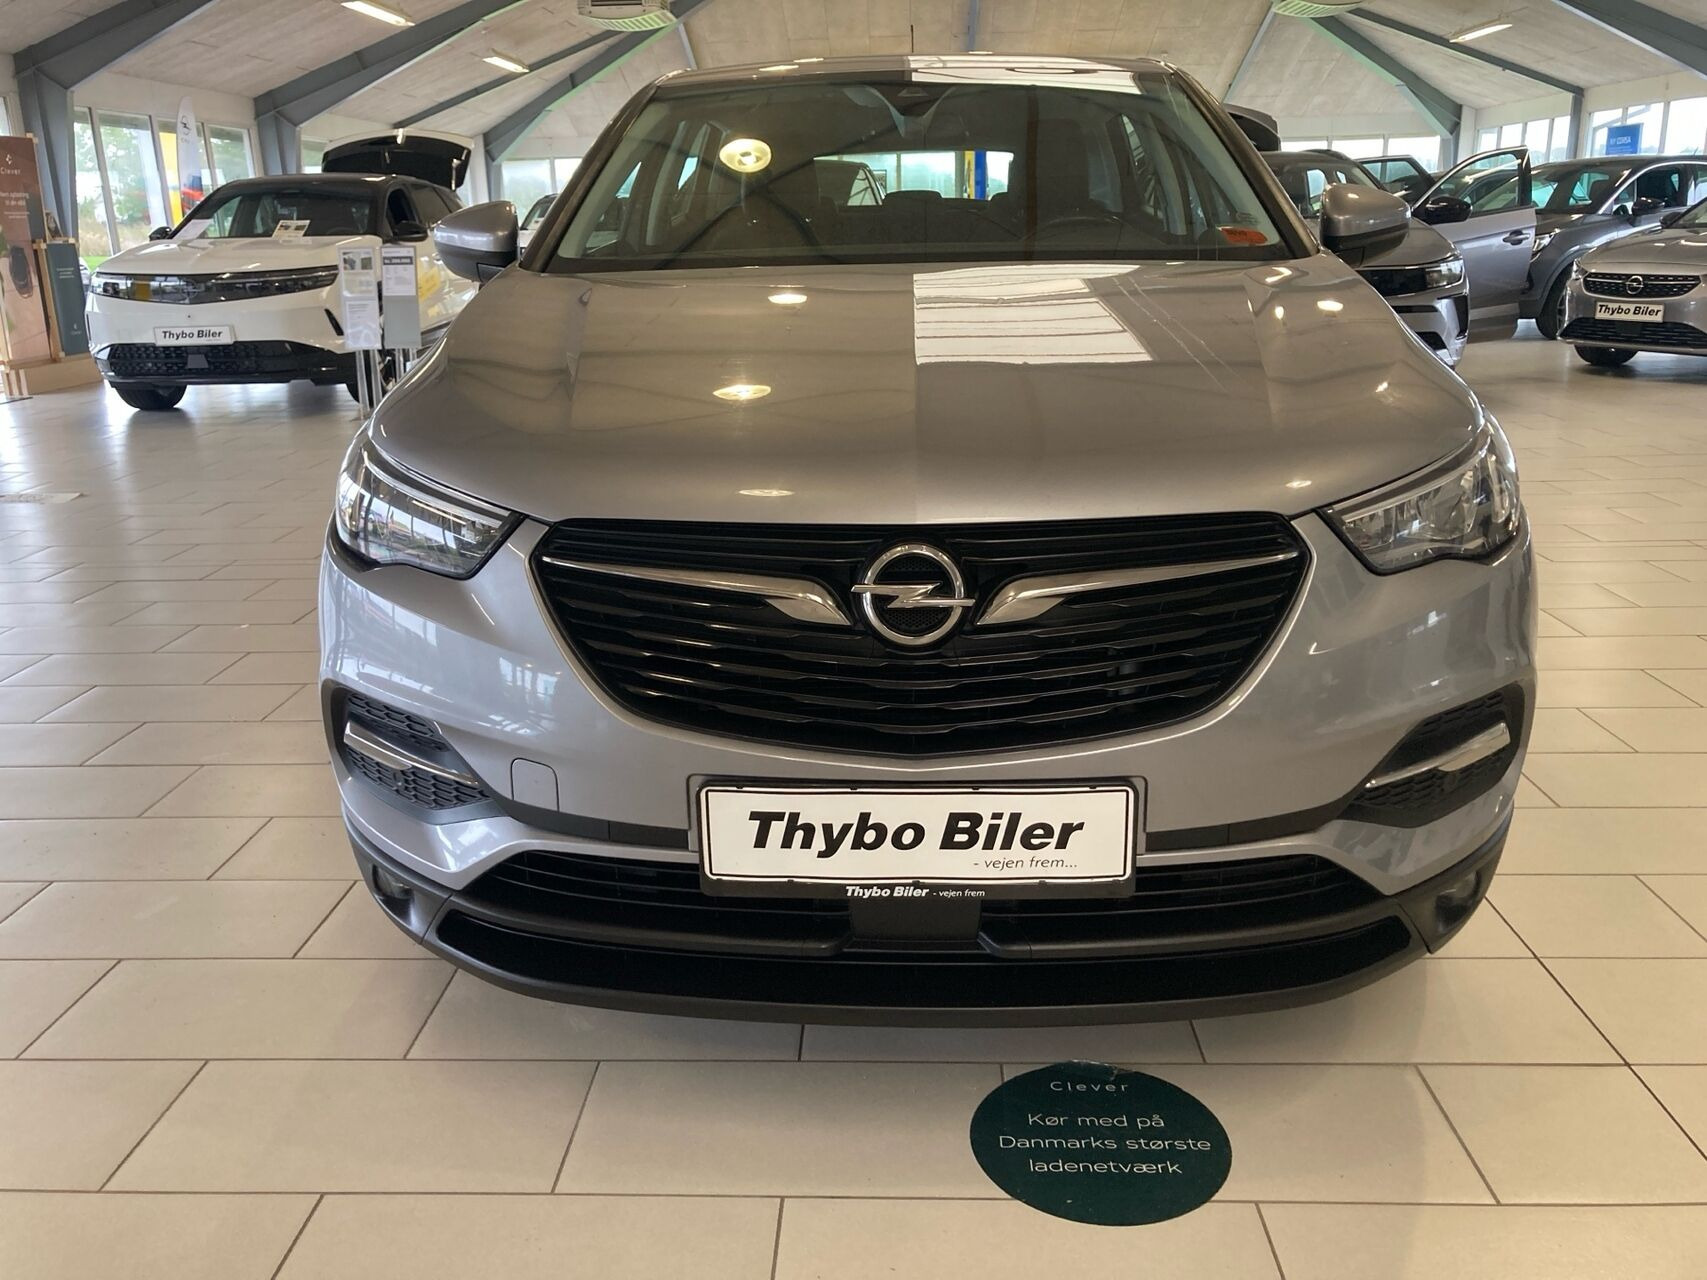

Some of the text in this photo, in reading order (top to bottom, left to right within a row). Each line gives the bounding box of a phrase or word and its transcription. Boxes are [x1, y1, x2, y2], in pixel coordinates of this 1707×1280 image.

[1599, 304, 1661, 317] Thybo Biler
[162, 329, 223, 341] Thybo Biler
[748, 811, 1085, 859] Thybo Biler
[984, 857, 1024, 871] vejen
[1029, 856, 1078, 869] frem...
[845, 886, 891, 898] Thybo
[893, 886, 929, 897] Biler
[938, 889, 962, 898] vejen
[964, 888, 985, 897] frem
[1050, 1081, 1128, 1092] Clever
[1028, 1113, 1165, 1130] Kør med på
[999, 1135, 1211, 1151] Danmarks største
[1029, 1158, 1183, 1174] ladenetværk
